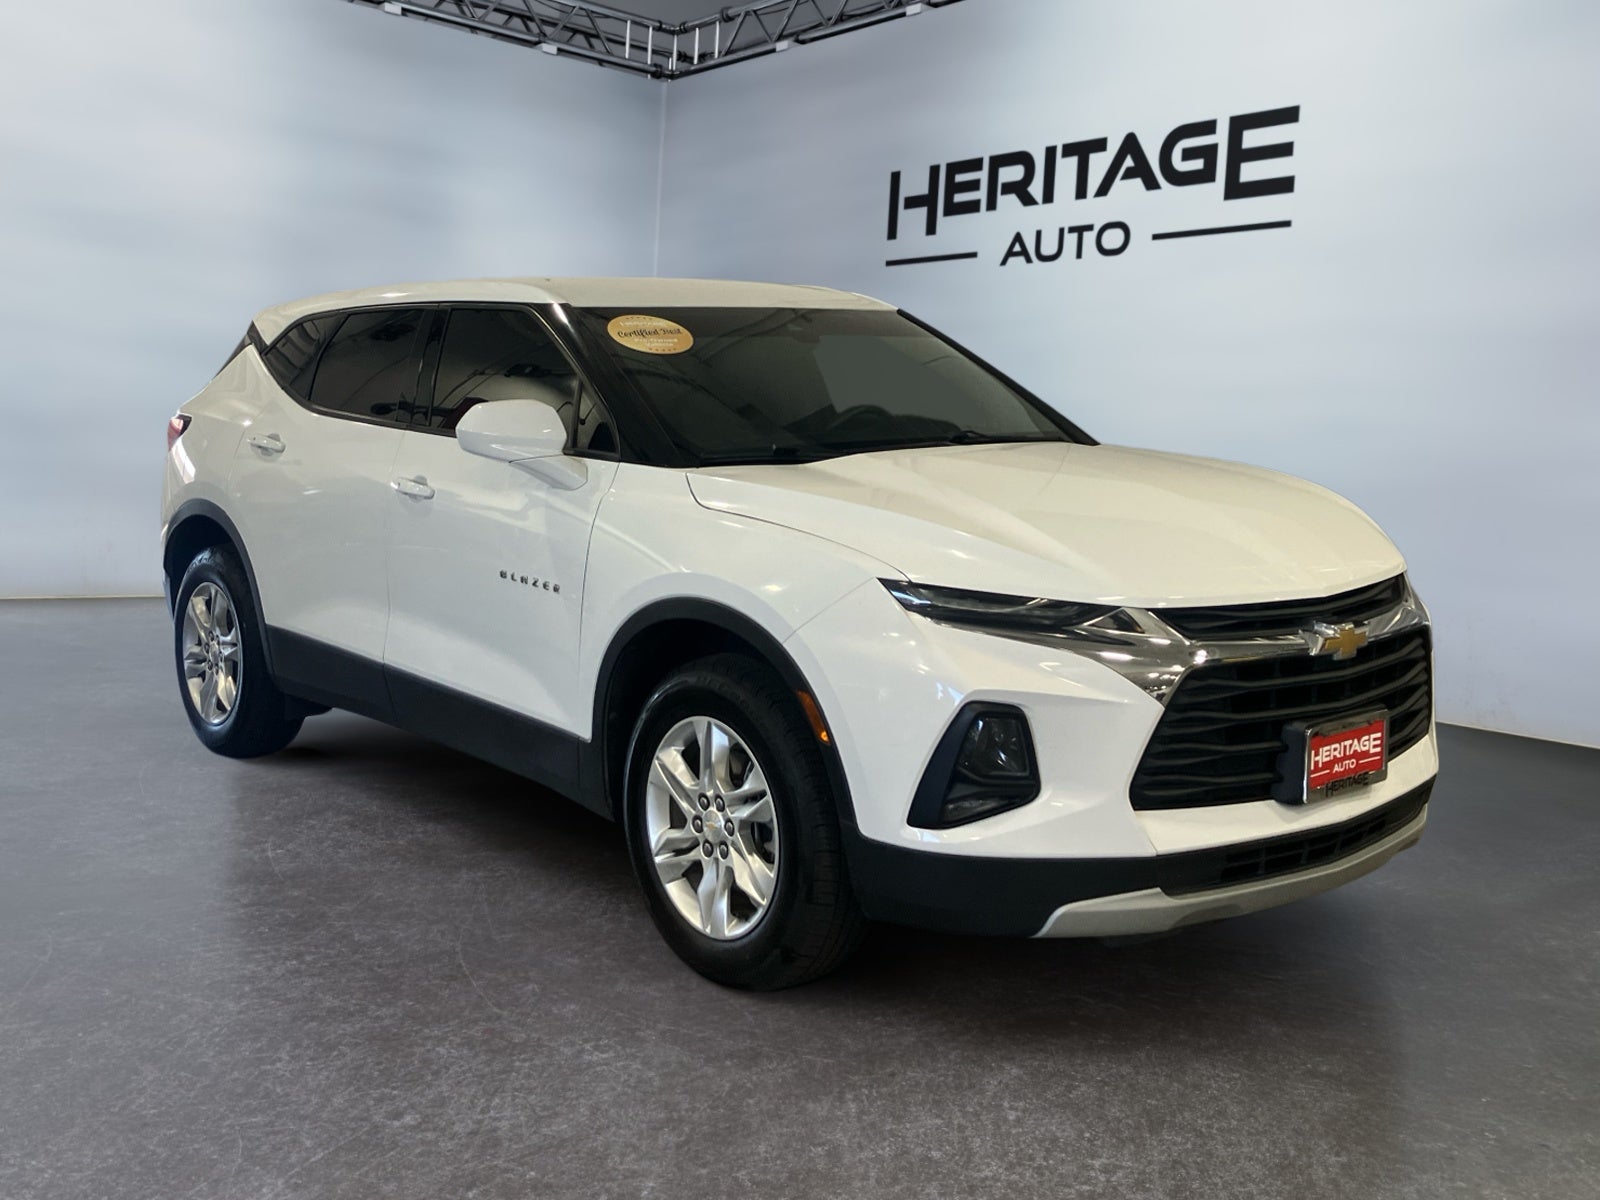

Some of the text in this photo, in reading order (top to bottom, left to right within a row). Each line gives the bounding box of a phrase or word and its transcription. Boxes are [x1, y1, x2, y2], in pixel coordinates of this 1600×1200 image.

[887, 105, 1300, 240] HERITAGE
[999, 221, 1131, 266] AUTO
[499, 569, 561, 594] BLAZER
[1310, 732, 1382, 770] HERITAGE
[1332, 759, 1357, 773] AUTO
[1325, 772, 1369, 797] HERITAGE
